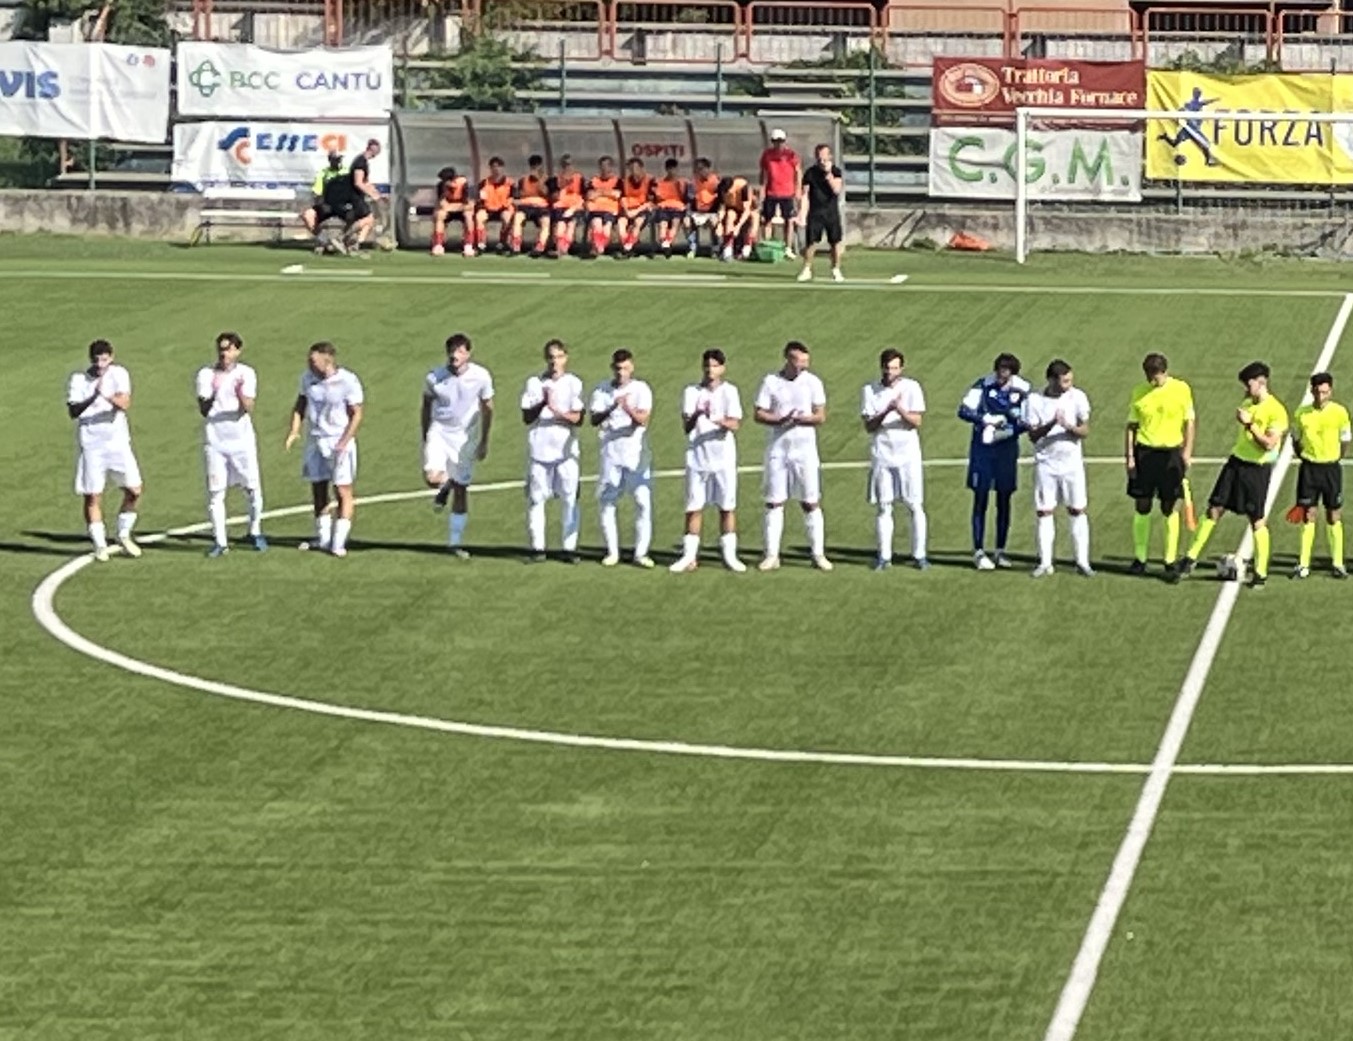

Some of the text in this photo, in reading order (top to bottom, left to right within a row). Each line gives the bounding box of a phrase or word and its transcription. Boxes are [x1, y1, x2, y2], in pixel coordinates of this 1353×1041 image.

[229, 67, 382, 90] BCC CANTÙ
[1001, 66, 1080, 85] Trattoria
[1002, 87, 1139, 106] Vecchia Fornace
[1213, 108, 1324, 146] FORZA
[631, 143, 685, 159] OSPITI
